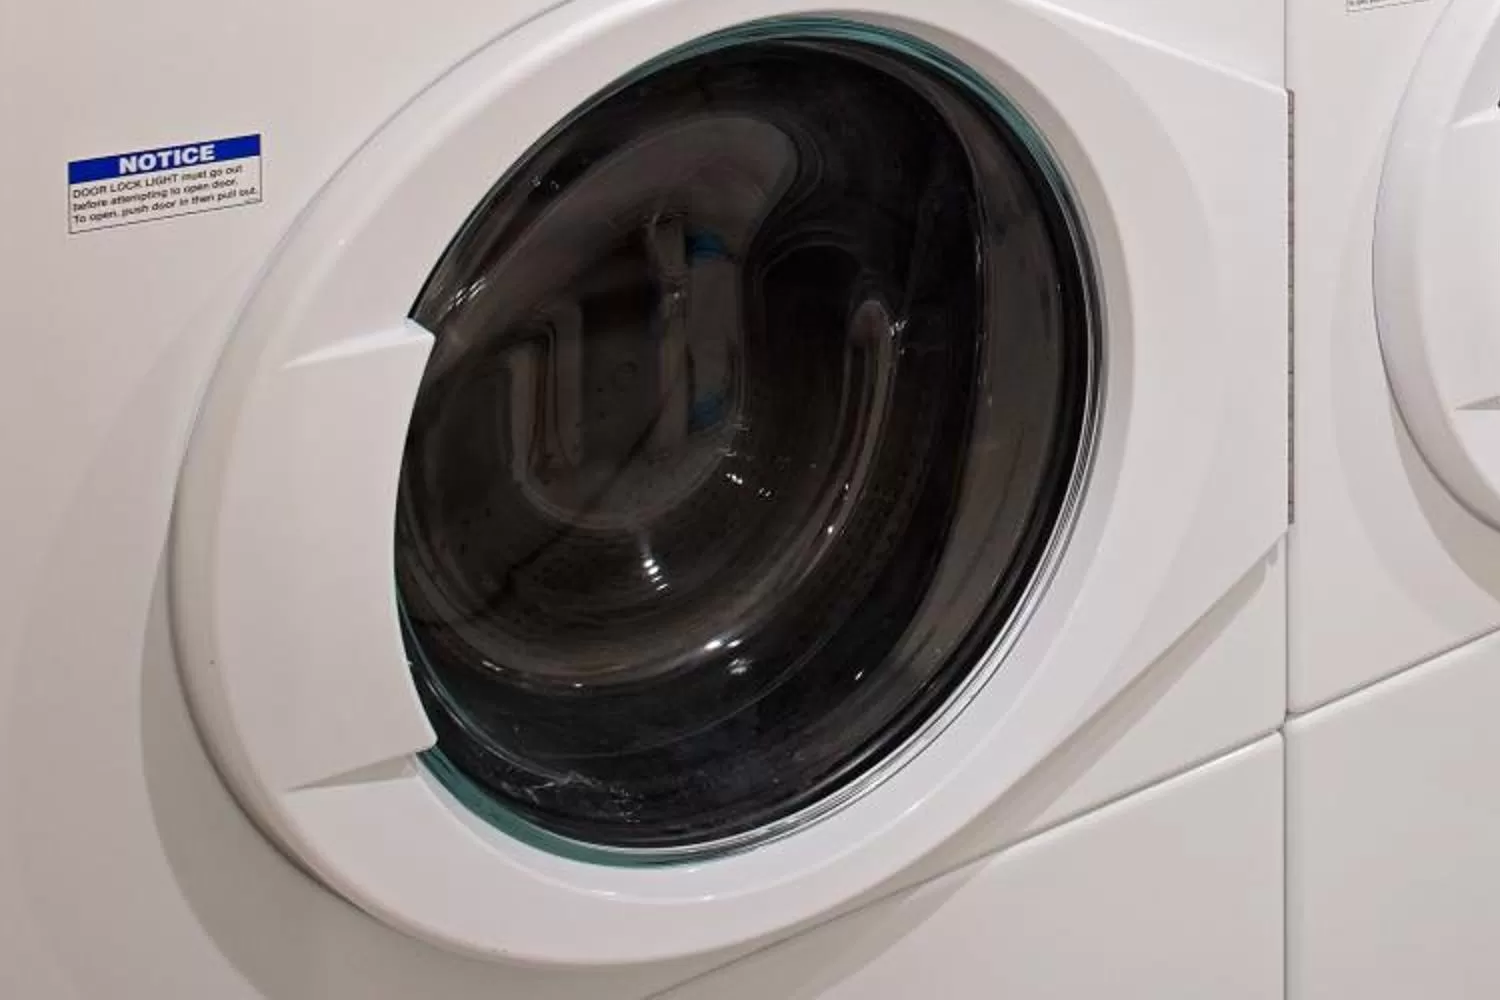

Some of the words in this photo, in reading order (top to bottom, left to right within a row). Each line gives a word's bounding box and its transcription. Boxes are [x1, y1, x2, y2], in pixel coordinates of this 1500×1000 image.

[119, 144, 216, 174] NOTICE
[73, 185, 107, 199] DOOR
[110, 179, 141, 193] LOCK
[145, 173, 178, 188] LIGHT
[210, 168, 223, 178] go
[226, 164, 243, 174] out
[73, 198, 108, 212] before
[111, 189, 168, 205] attempting
[184, 183, 209, 194] open
[73, 214, 87, 223] To
[121, 204, 149, 217] push
[152, 199, 176, 210] door
[217, 189, 237, 201] pull
